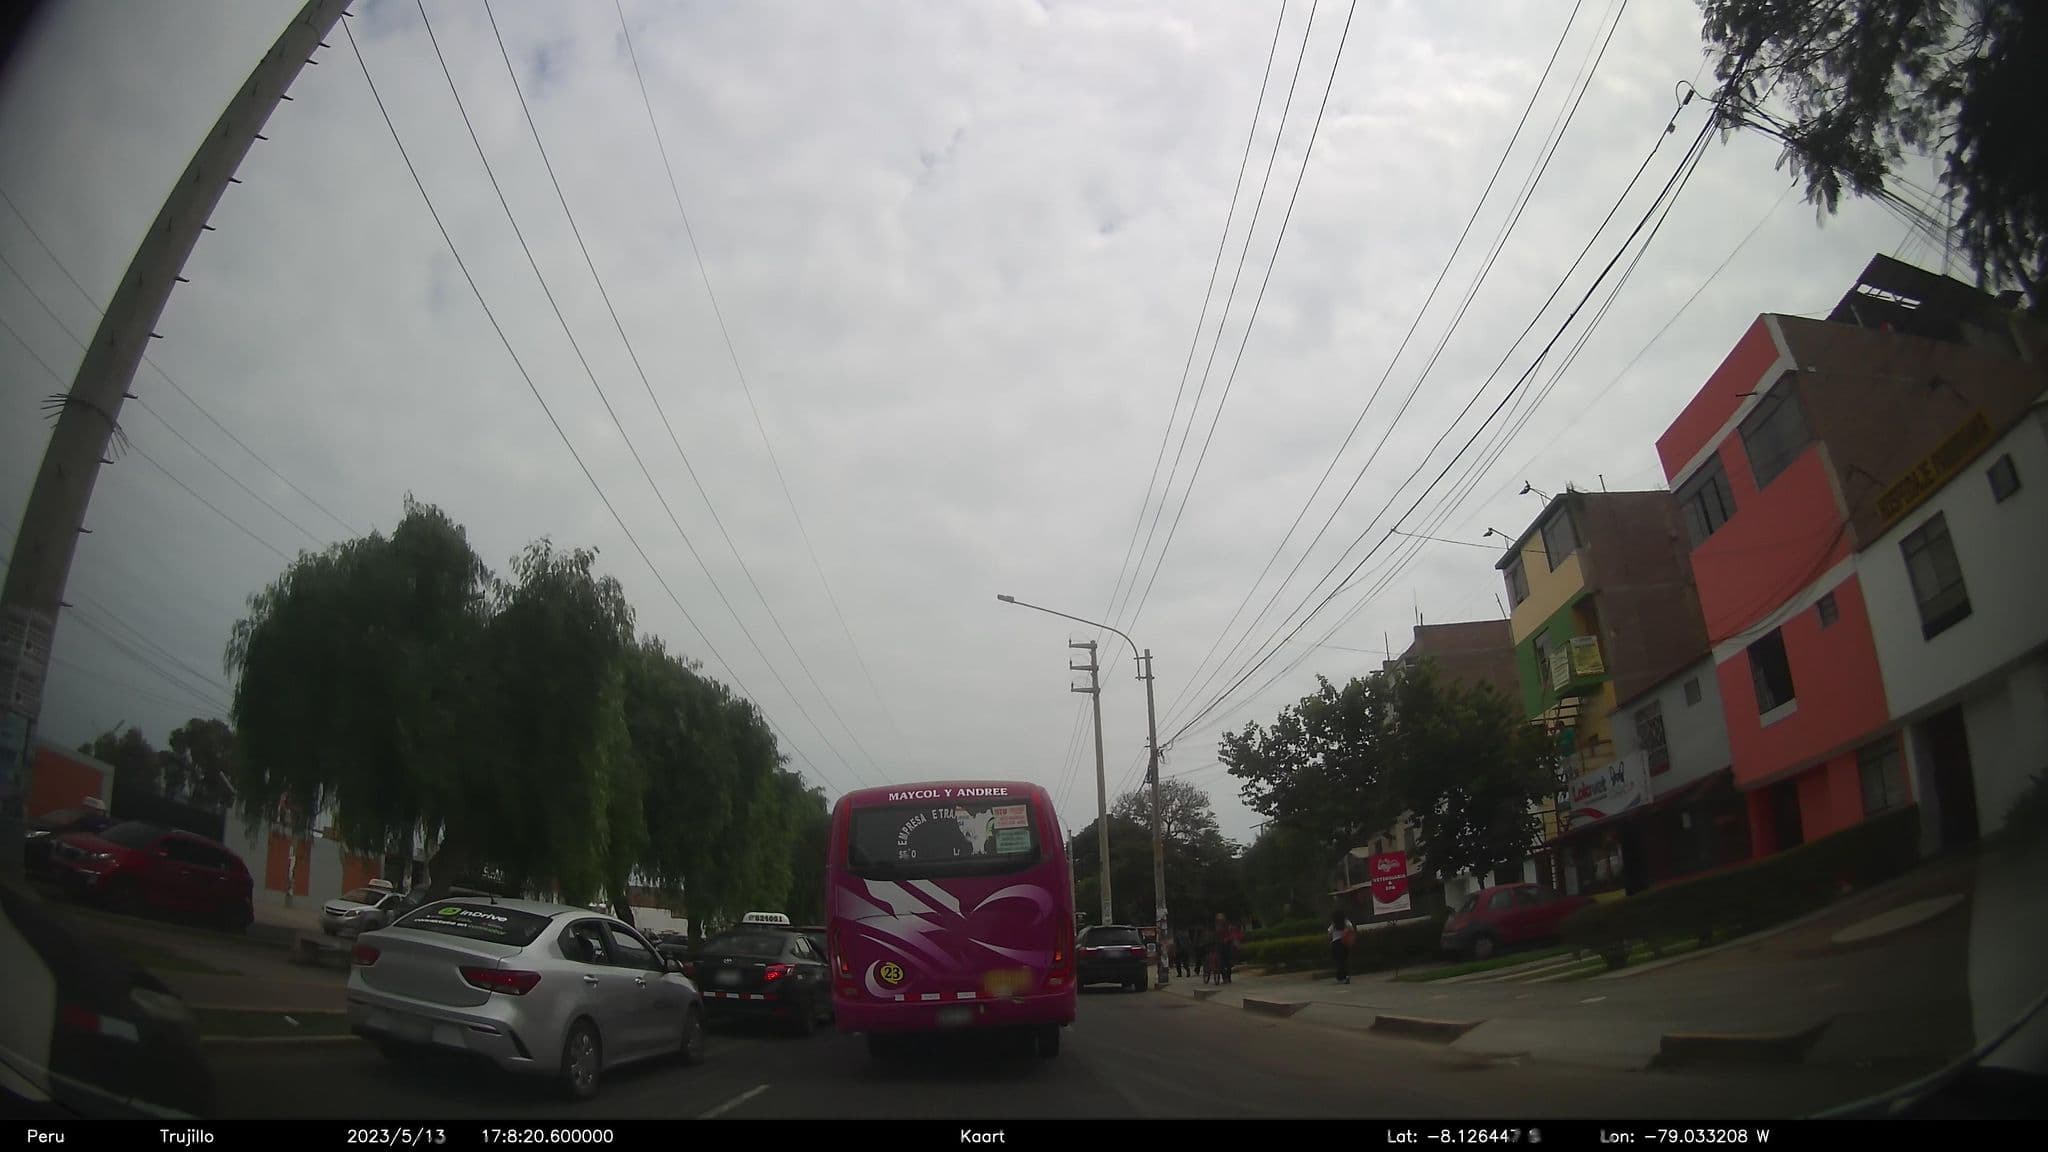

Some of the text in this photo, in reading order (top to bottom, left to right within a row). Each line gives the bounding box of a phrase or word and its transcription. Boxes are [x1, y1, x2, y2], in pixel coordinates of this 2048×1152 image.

[889, 787, 1008, 802] MAYCOL Y ANDREE
[897, 813, 927, 846] EMPRESA
[884, 966, 901, 980] 23
